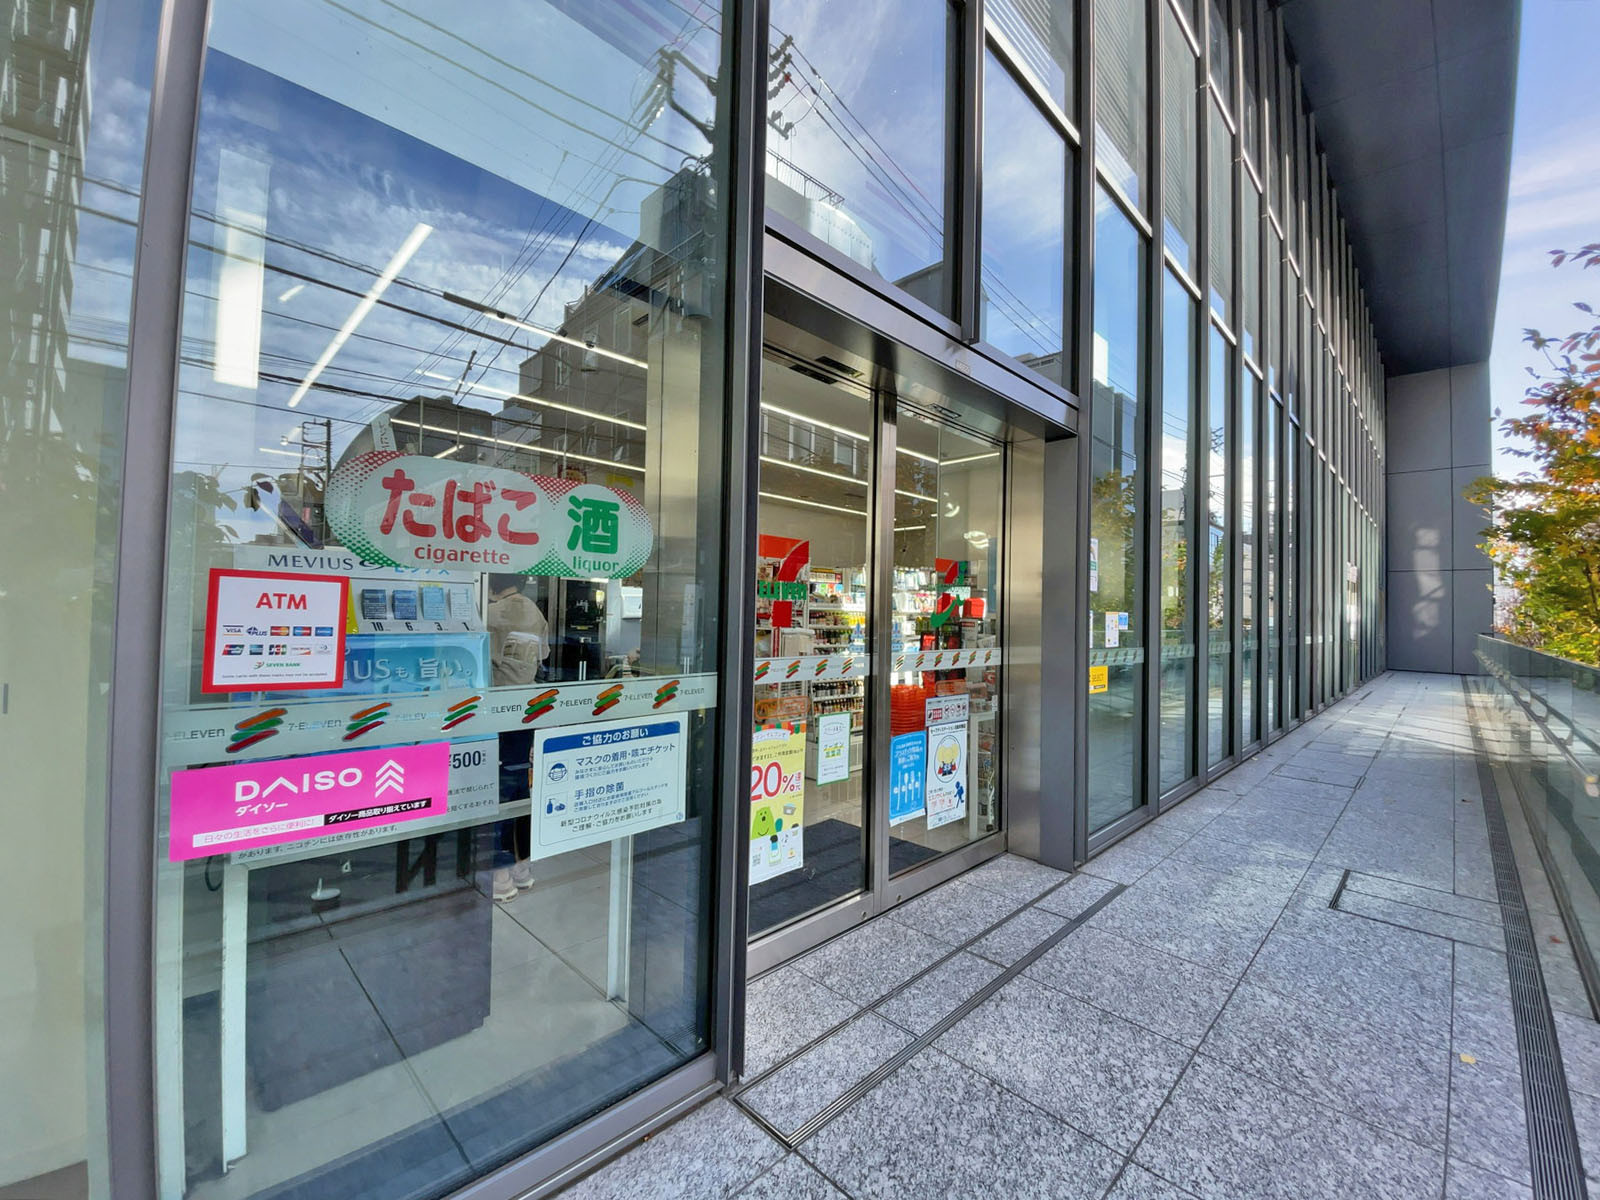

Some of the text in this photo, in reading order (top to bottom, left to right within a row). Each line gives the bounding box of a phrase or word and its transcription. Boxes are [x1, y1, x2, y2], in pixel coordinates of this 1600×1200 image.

[379, 469, 540, 545] たばこ
[567, 495, 621, 554] 酒
[267, 553, 354, 571] MEVIUS
[414, 544, 510, 566] cigarette
[572, 557, 620, 573] liquor
[255, 592, 308, 610] ATM
[582, 727, 649, 746] ご協力のお願い
[235, 767, 362, 802] DAISO
[574, 781, 625, 800] 手指の除菌
[751, 761, 795, 802] 20%
[235, 802, 289, 817] ダイソー
